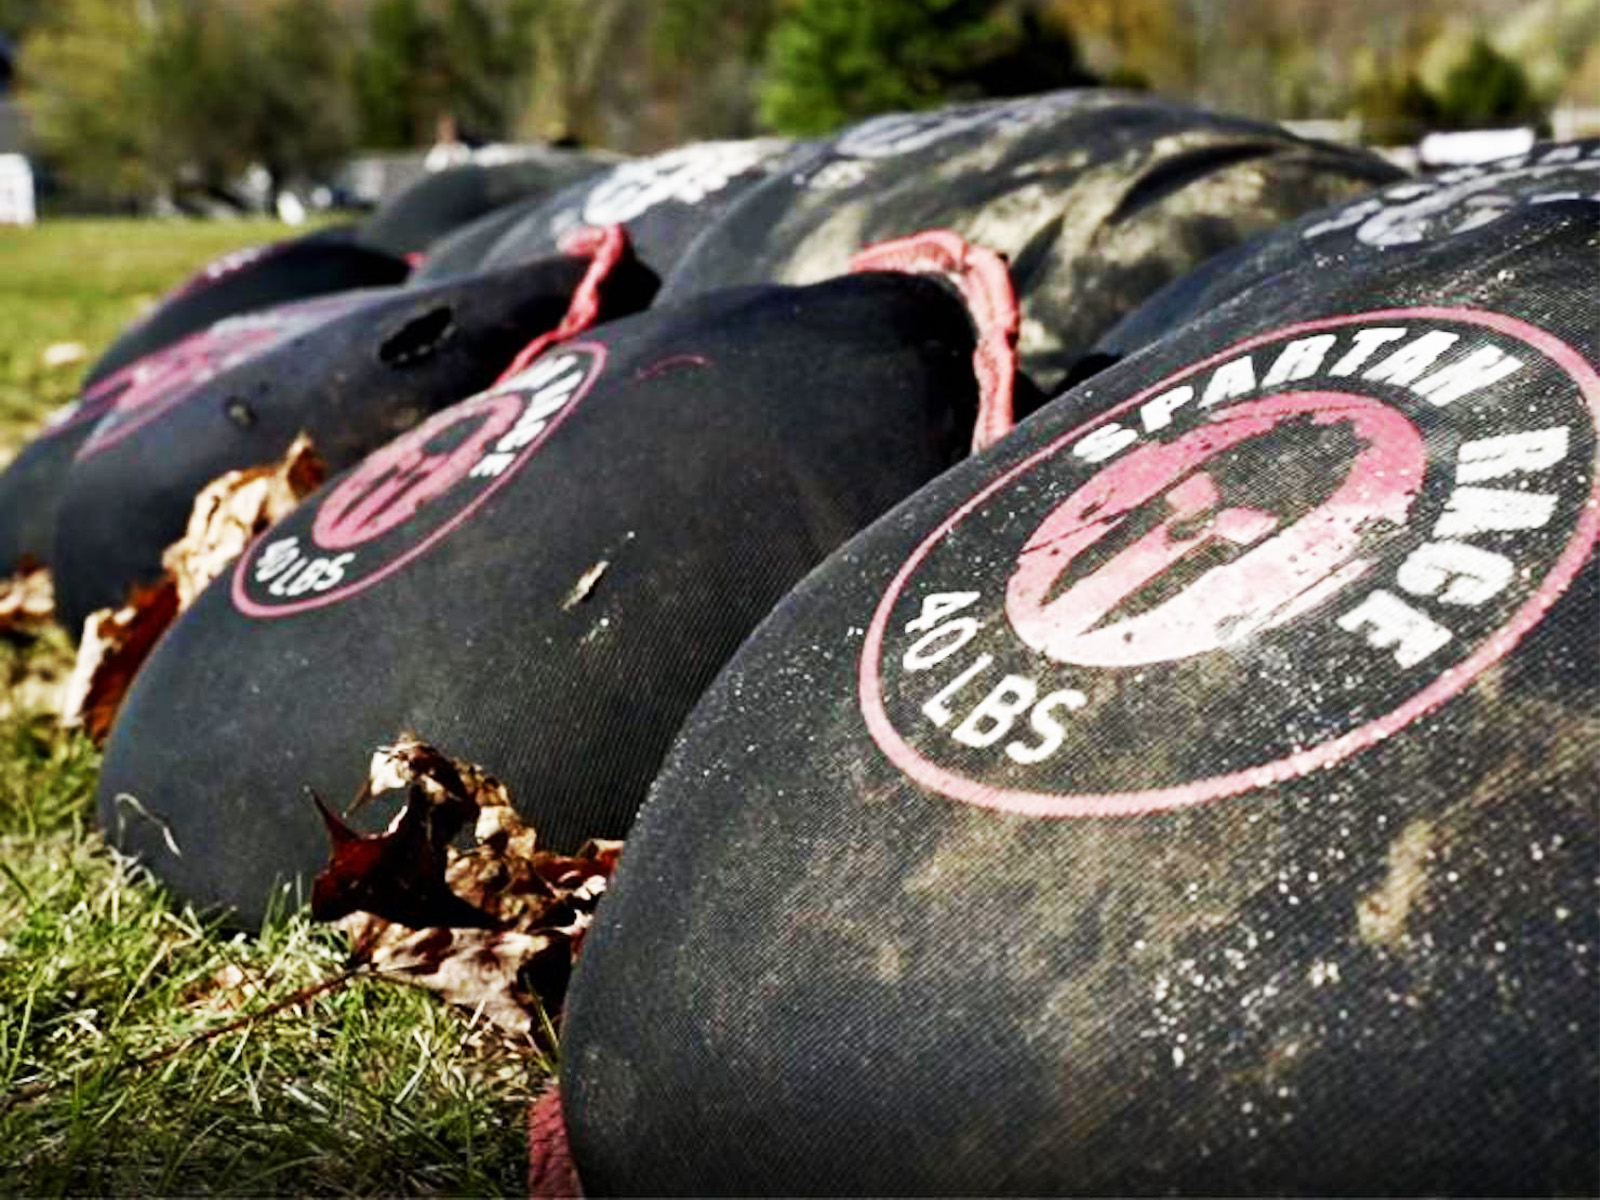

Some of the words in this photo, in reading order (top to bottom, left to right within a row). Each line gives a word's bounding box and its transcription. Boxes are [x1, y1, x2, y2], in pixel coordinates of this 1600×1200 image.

[1072, 327, 1525, 464] SPARTAN
[1336, 425, 1571, 670] RACE
[269, 552, 355, 597] LBS
[902, 590, 981, 672] 40
[921, 653, 1088, 765] LBS
